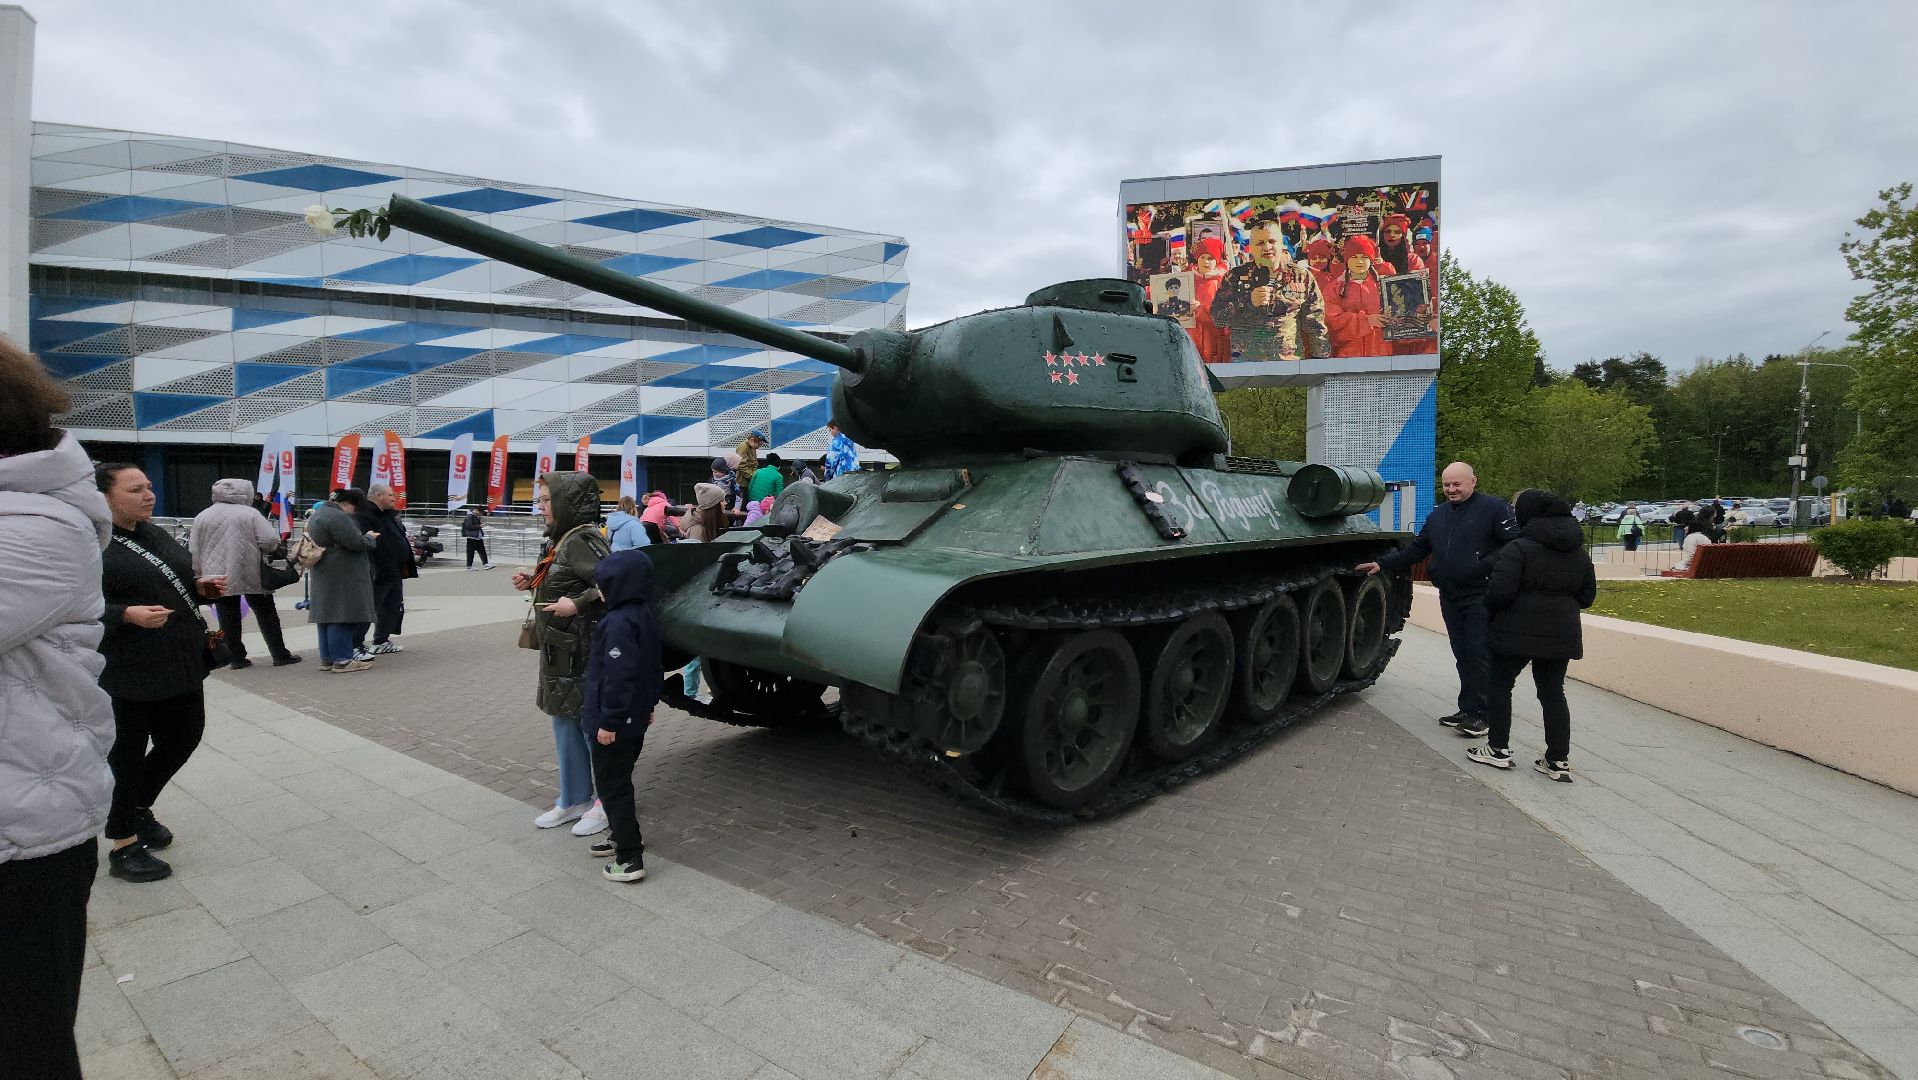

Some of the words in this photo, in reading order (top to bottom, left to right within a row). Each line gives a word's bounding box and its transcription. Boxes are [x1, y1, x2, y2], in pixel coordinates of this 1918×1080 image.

[281, 451, 293, 470] 9
[336, 446, 352, 484] ПОБЕДА!
[377, 454, 388, 472] 9
[389, 442, 403, 486] ПОБЕДА!
[455, 454, 467, 473] 9
[491, 448, 503, 488] ПОБЕДА!
[578, 446, 589, 472] ЕДА!
[1200, 480, 1281, 531] Родину!
[124, 539, 144, 555] NICE
[142, 551, 162, 567] NICE
[159, 563, 177, 581] NICE
[172, 578, 187, 596] NICE
[183, 593, 196, 610] NICE
